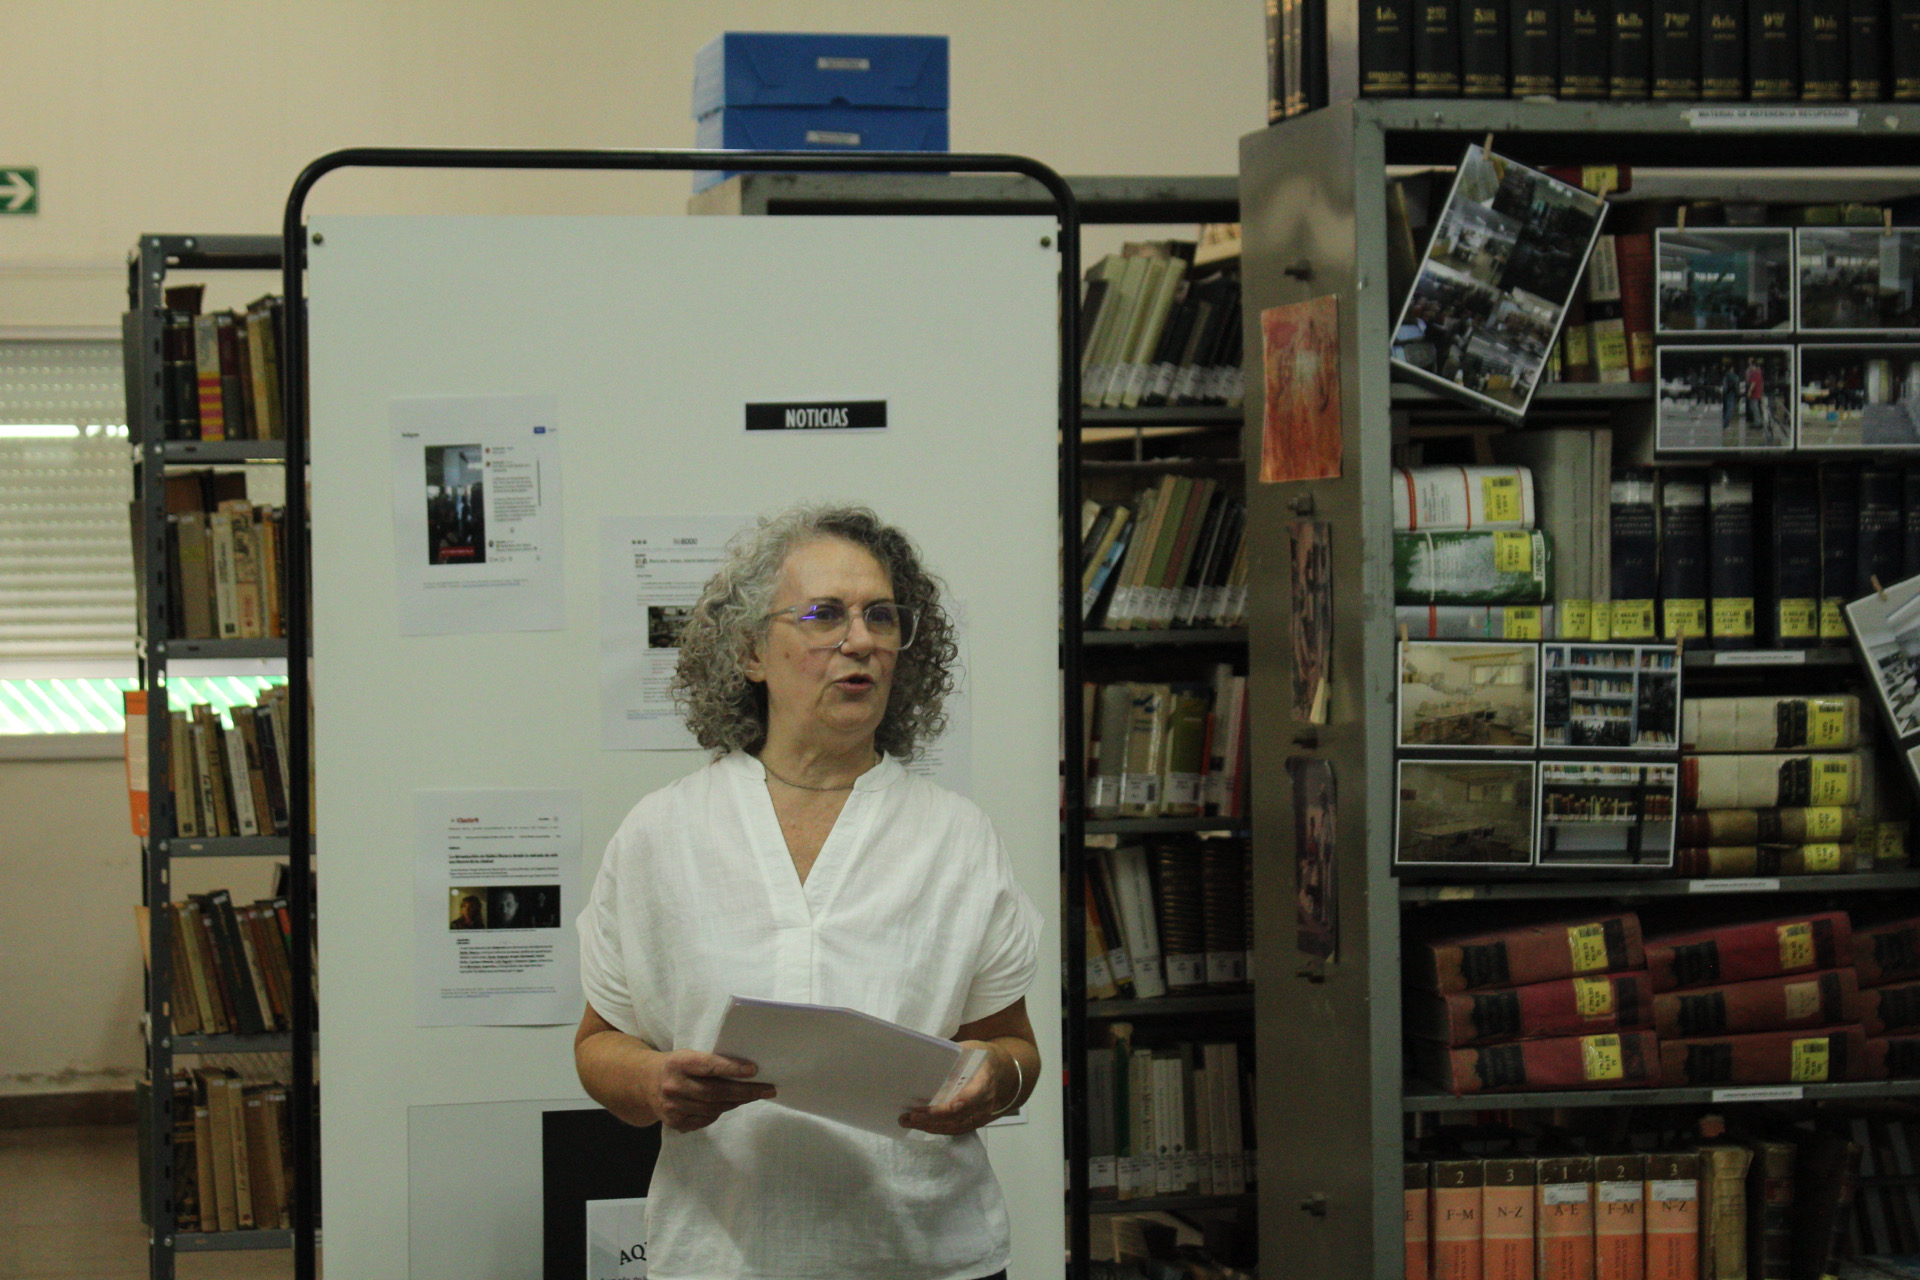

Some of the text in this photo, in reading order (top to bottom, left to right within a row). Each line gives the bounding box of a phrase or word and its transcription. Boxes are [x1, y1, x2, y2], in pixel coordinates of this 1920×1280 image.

[785, 408, 849, 428] NOTICIAS
[1506, 1168, 1515, 1182] 3
[1562, 1166, 1568, 1180] 1
[1617, 1165, 1625, 1178] 2
[1670, 1163, 1678, 1176] 3
[1456, 1170, 1465, 1184] 2
[620, 1242, 648, 1265] AQ
